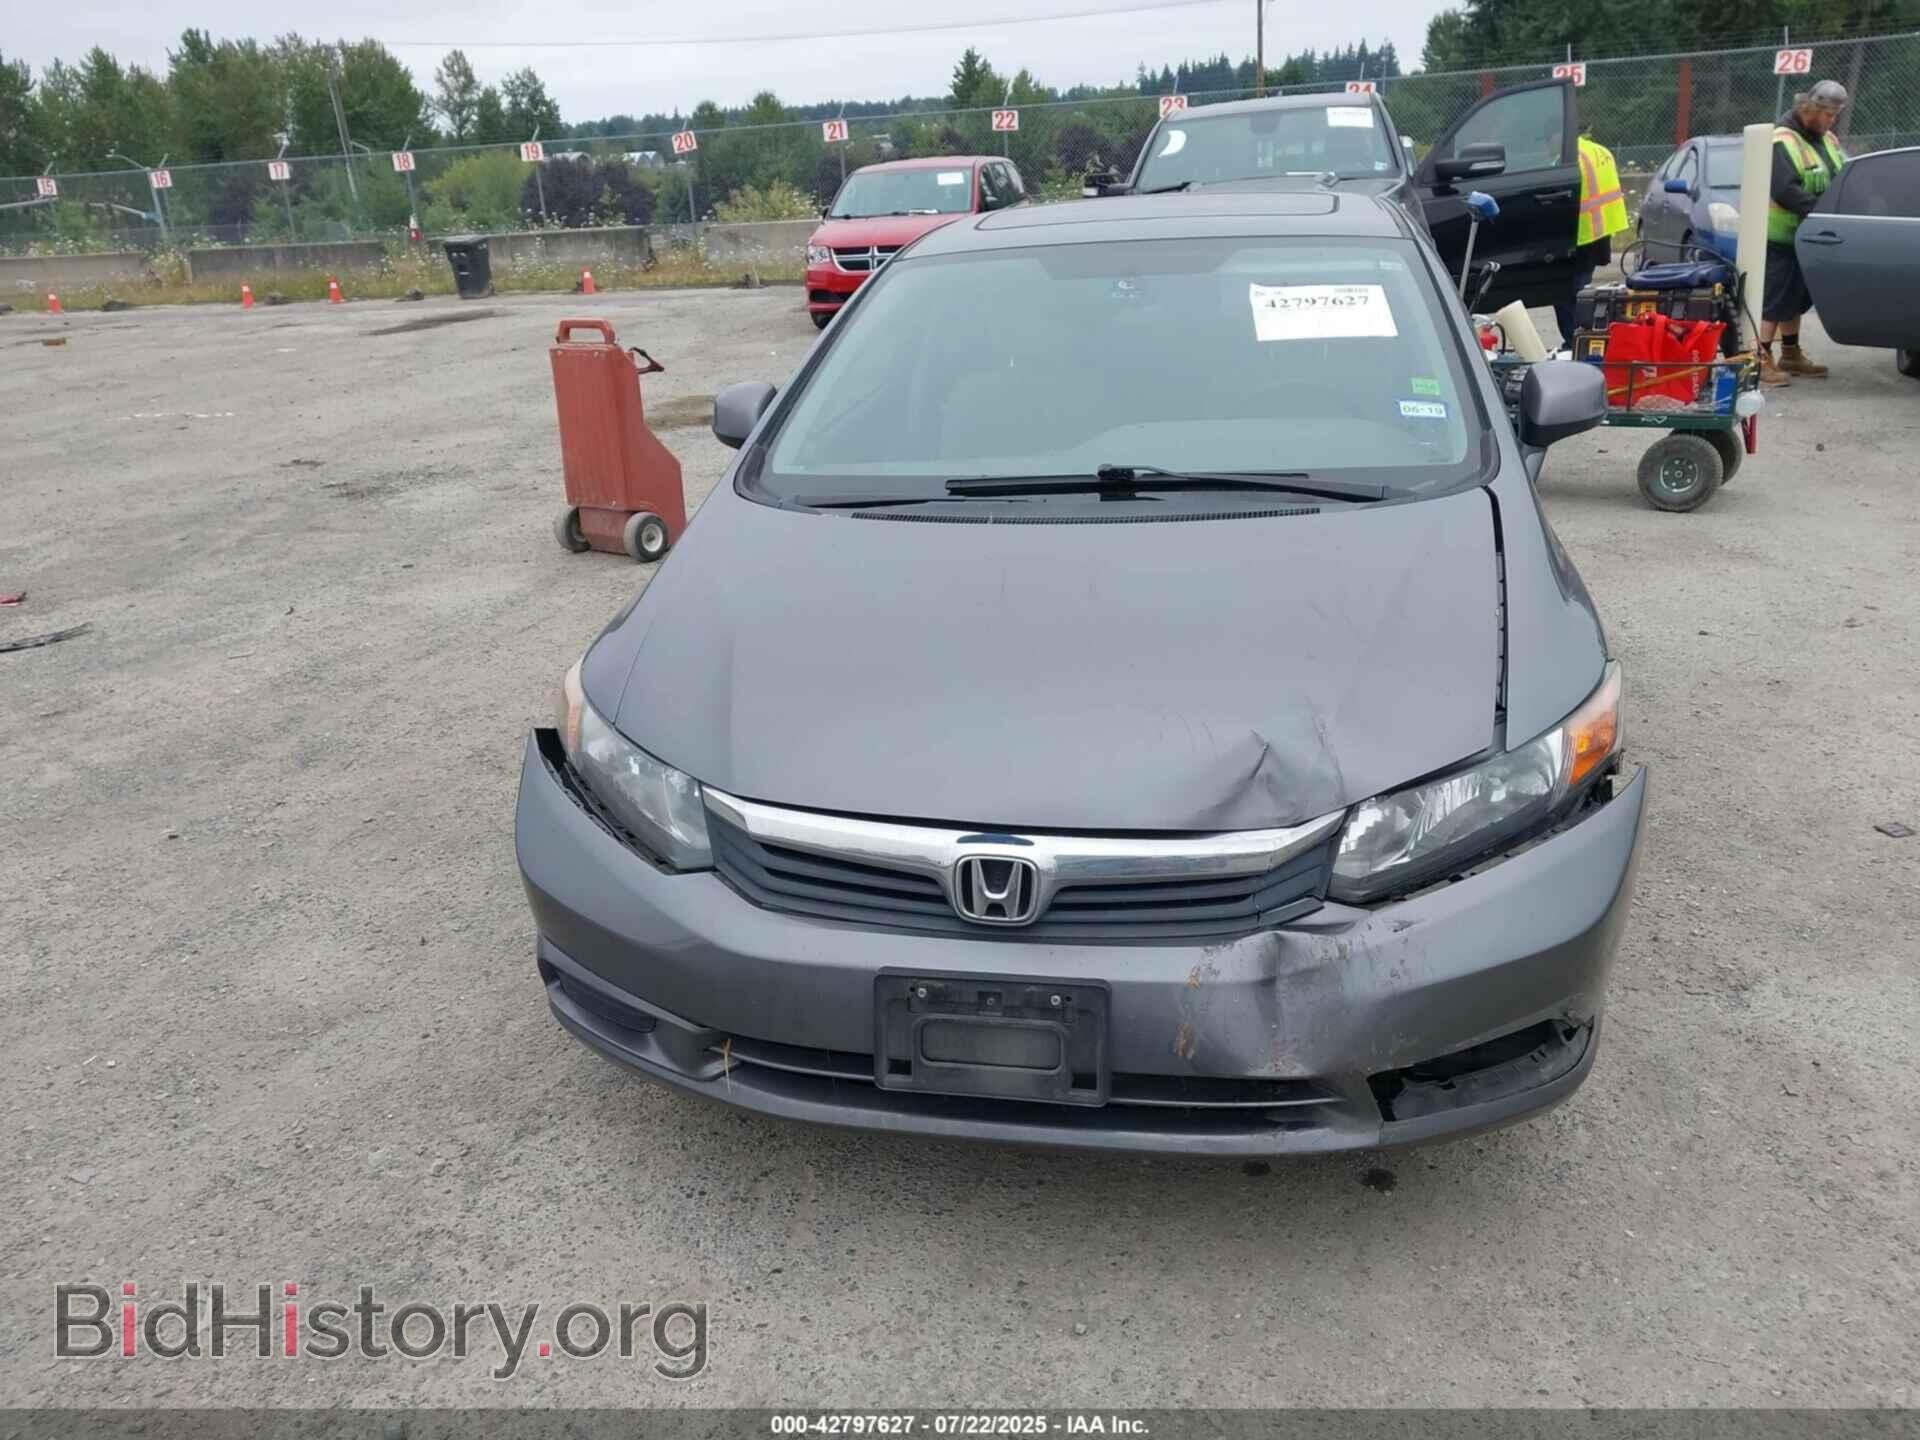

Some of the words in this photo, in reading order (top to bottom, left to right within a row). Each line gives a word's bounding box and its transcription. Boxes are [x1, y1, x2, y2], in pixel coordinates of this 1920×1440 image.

[1779, 51, 1807, 71] 26
[995, 112, 1015, 129] 22
[828, 123, 844, 139] 21
[674, 132, 694, 151] 20
[525, 143, 540, 160] 19
[397, 153, 411, 169] 18
[273, 163, 284, 177] 17
[40, 179, 54, 193] 15
[154, 171, 168, 186] 16
[1264, 295, 1369, 308] 42797627
